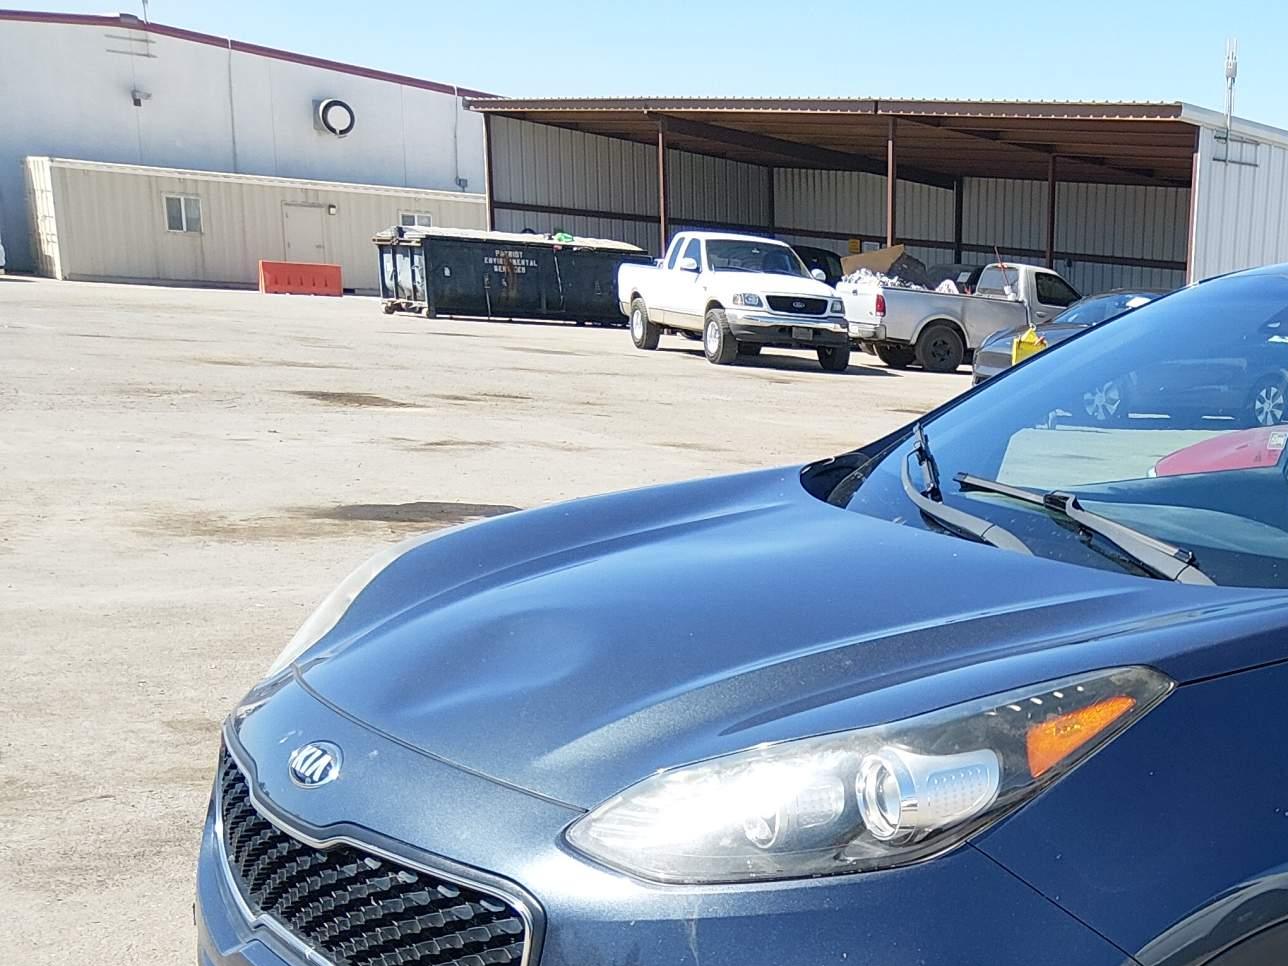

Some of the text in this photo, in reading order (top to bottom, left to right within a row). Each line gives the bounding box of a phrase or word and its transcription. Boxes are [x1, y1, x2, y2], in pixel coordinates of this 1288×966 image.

[484, 256, 538, 267] ENVIRMENTAL
[493, 265, 526, 274] SERVCES
[291, 745, 332, 782] KIA
